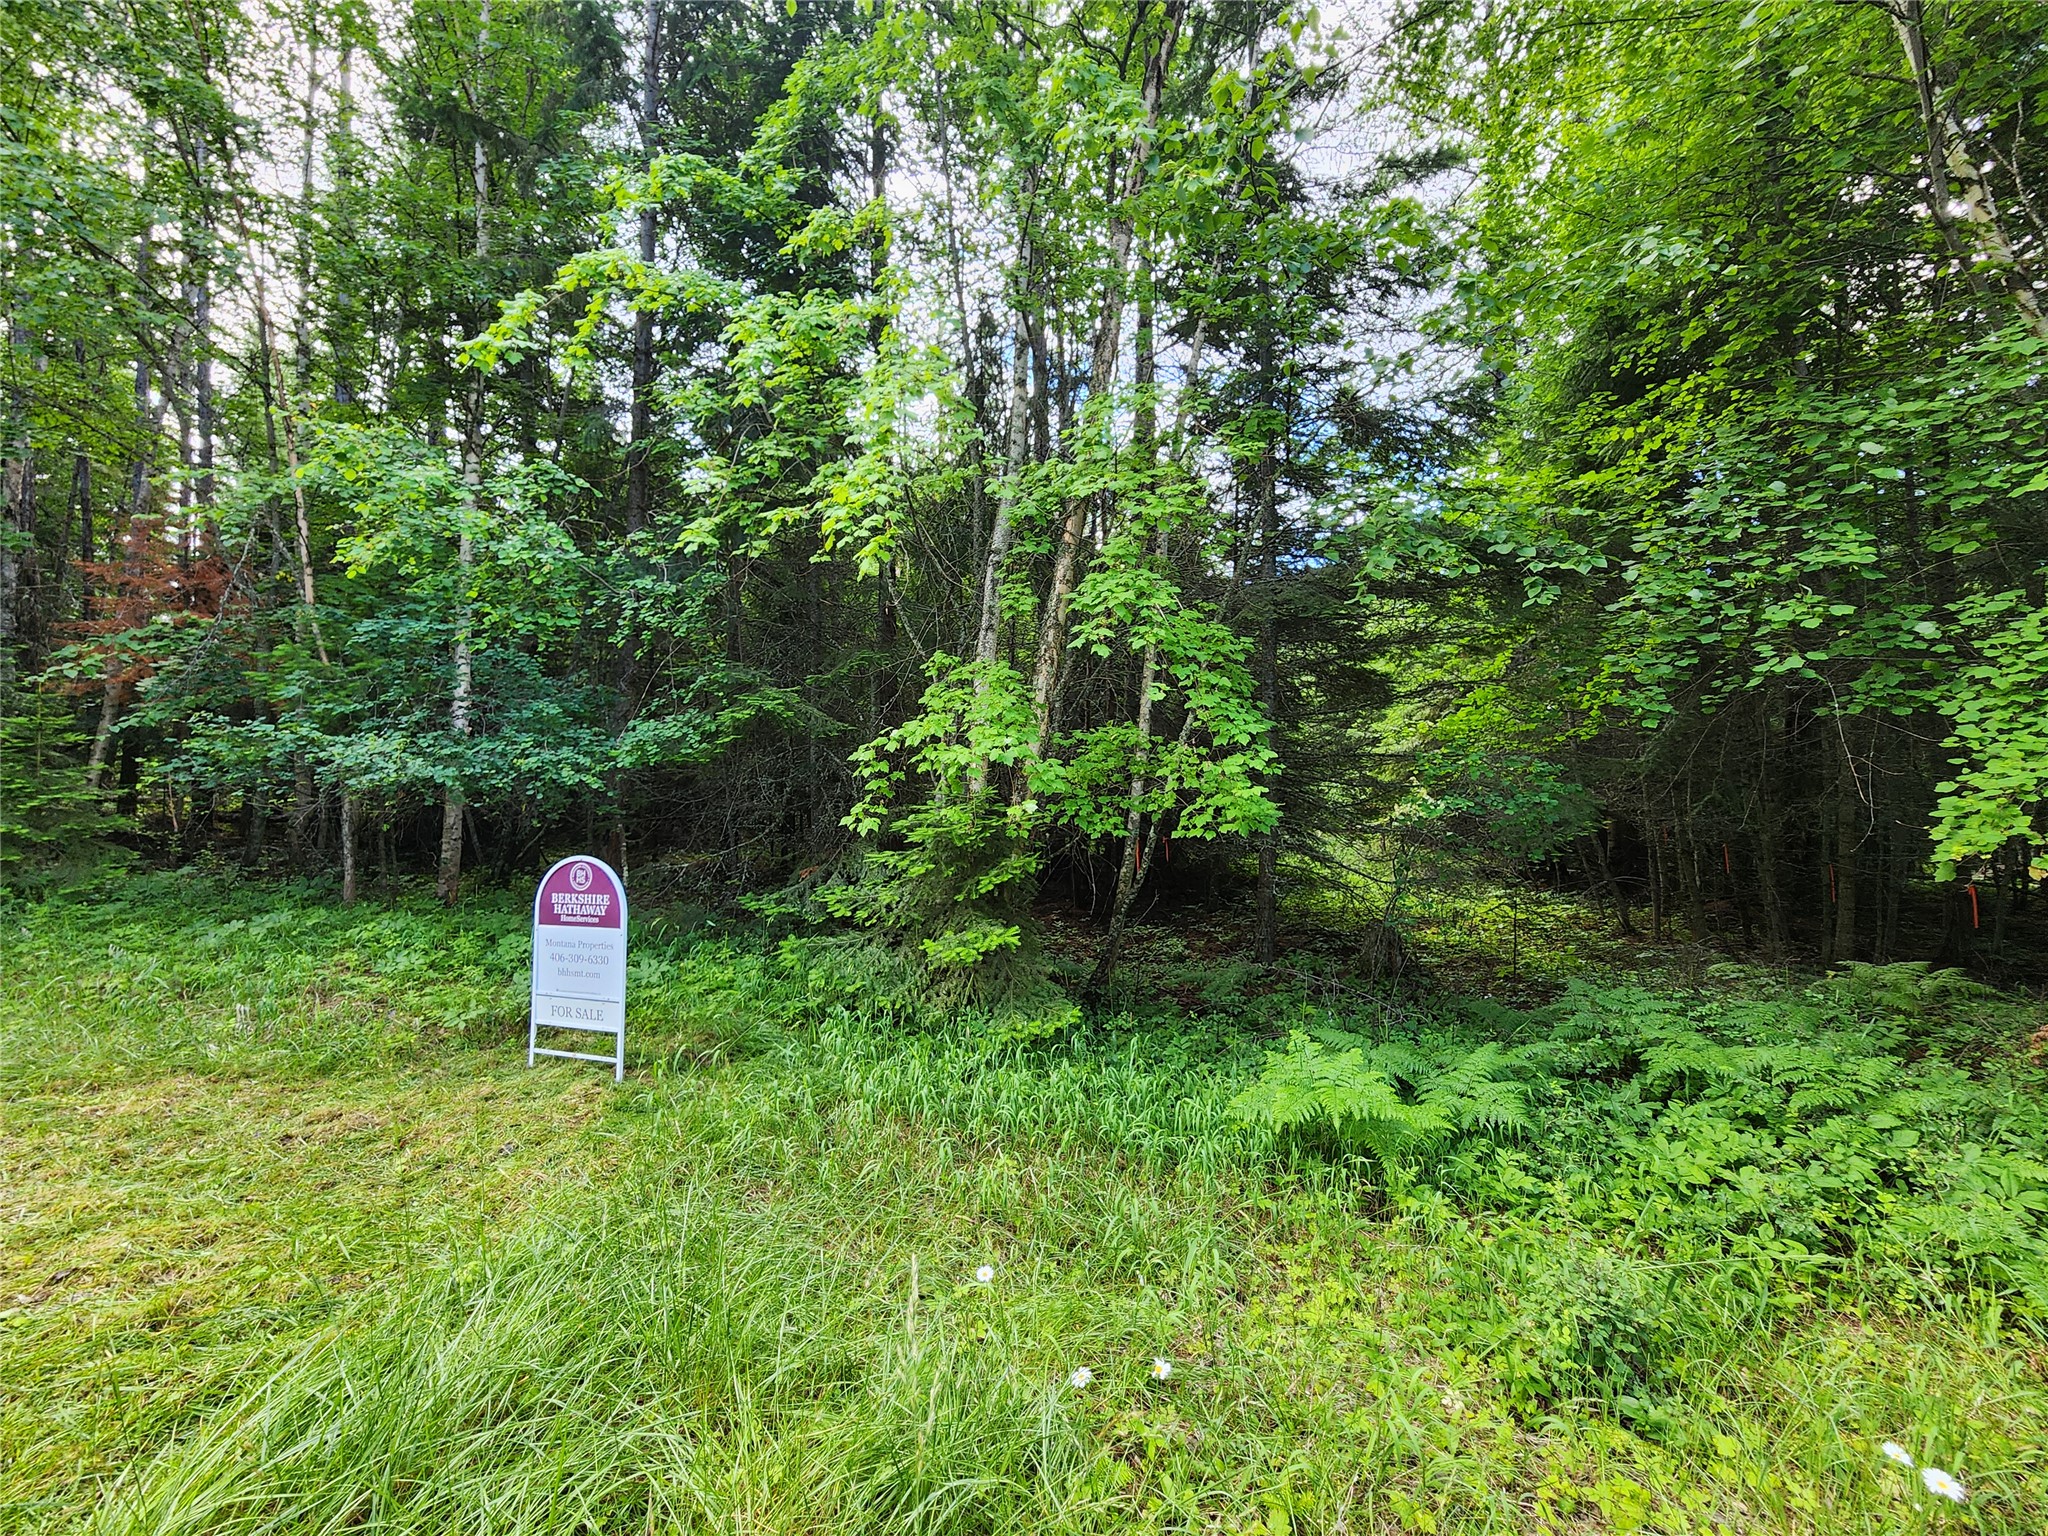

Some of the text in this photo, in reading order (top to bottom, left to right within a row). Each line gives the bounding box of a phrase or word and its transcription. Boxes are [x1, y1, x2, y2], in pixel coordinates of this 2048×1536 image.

[551, 893, 610, 905] BERKSHIRE
[553, 904, 607, 915] HATHAWAY
[560, 914, 599, 923] HomeServices
[545, 939, 614, 951] Montana Properties
[550, 953, 609, 965] 406-309-6330
[557, 968, 601, 979] bhhsmt.com
[551, 1005, 604, 1021] FOR SALE
